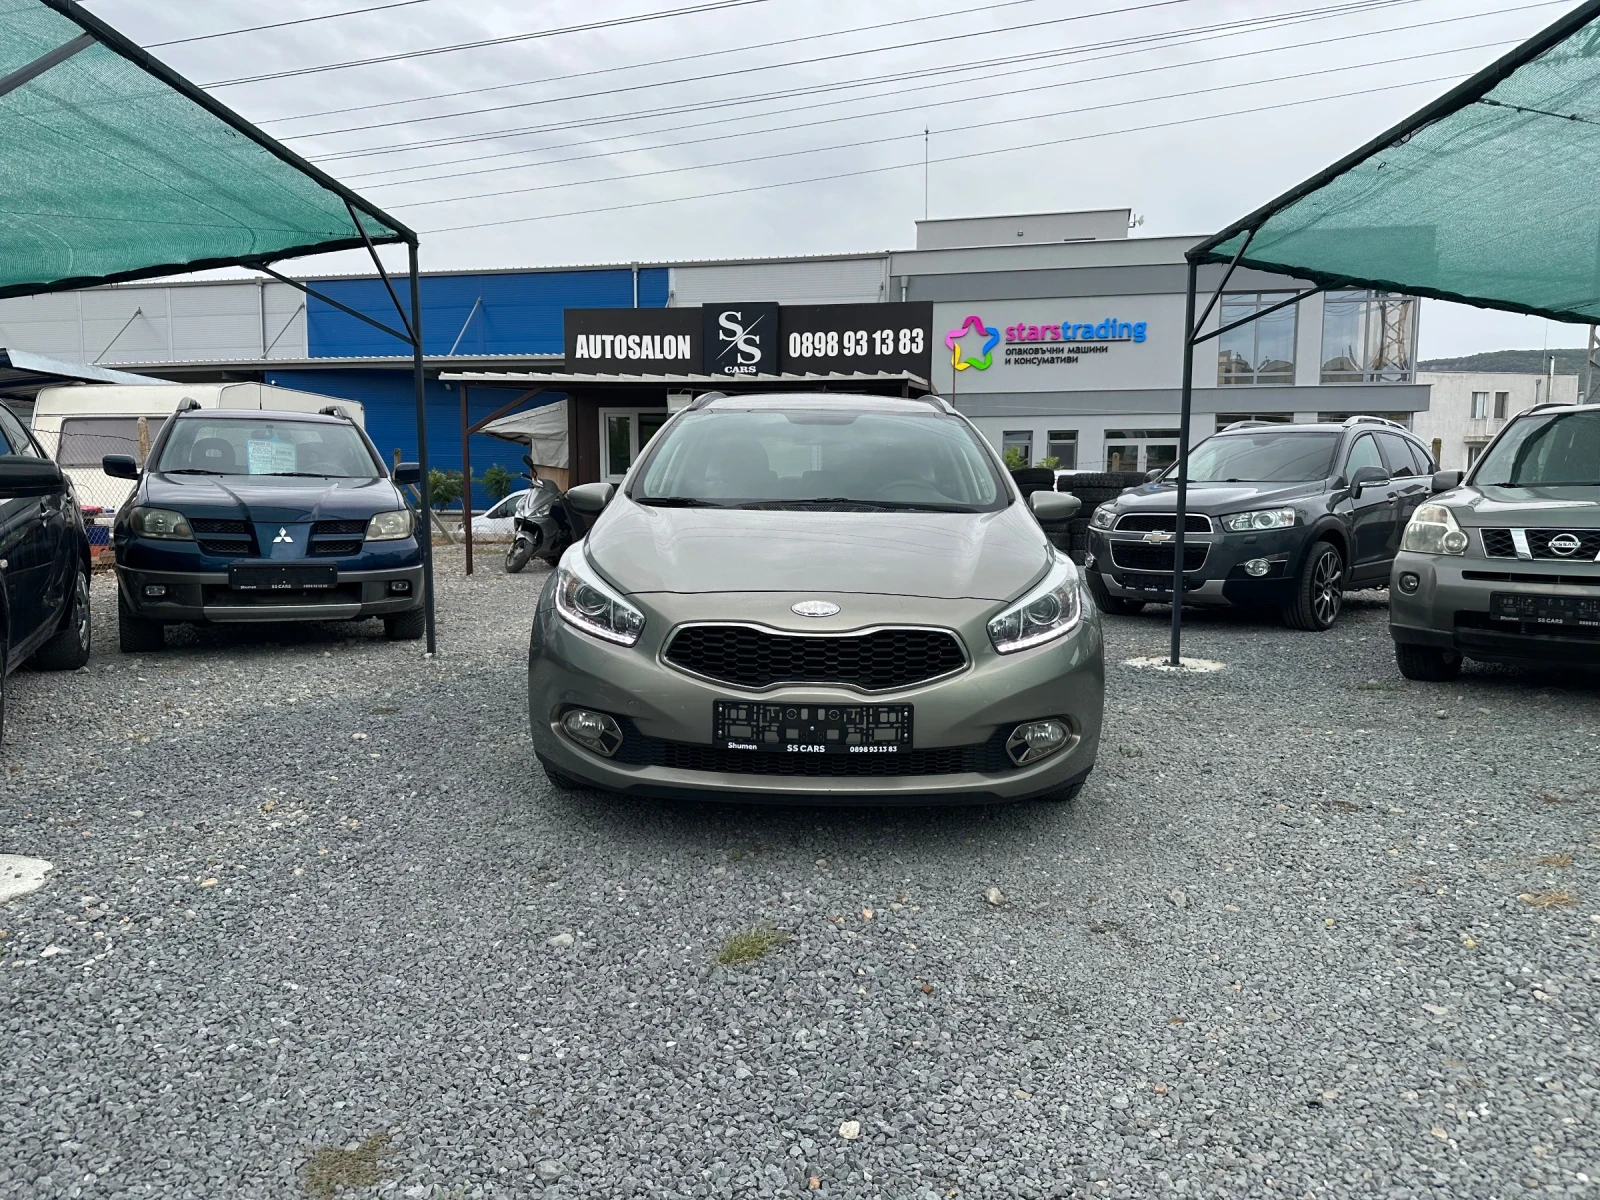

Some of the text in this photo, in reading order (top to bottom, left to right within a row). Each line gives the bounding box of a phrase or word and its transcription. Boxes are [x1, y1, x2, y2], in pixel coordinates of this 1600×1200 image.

[1006, 318, 1147, 342] starstrading
[575, 334, 691, 360] AUTOSALON
[789, 328, 924, 358] 0898 93 13 83
[1005, 346, 1108, 356] опаковъчни машини
[1014, 356, 1079, 366] консумативи
[724, 365, 757, 374] CARS
[728, 741, 758, 750] Shumen
[786, 744, 826, 753] SS CARS
